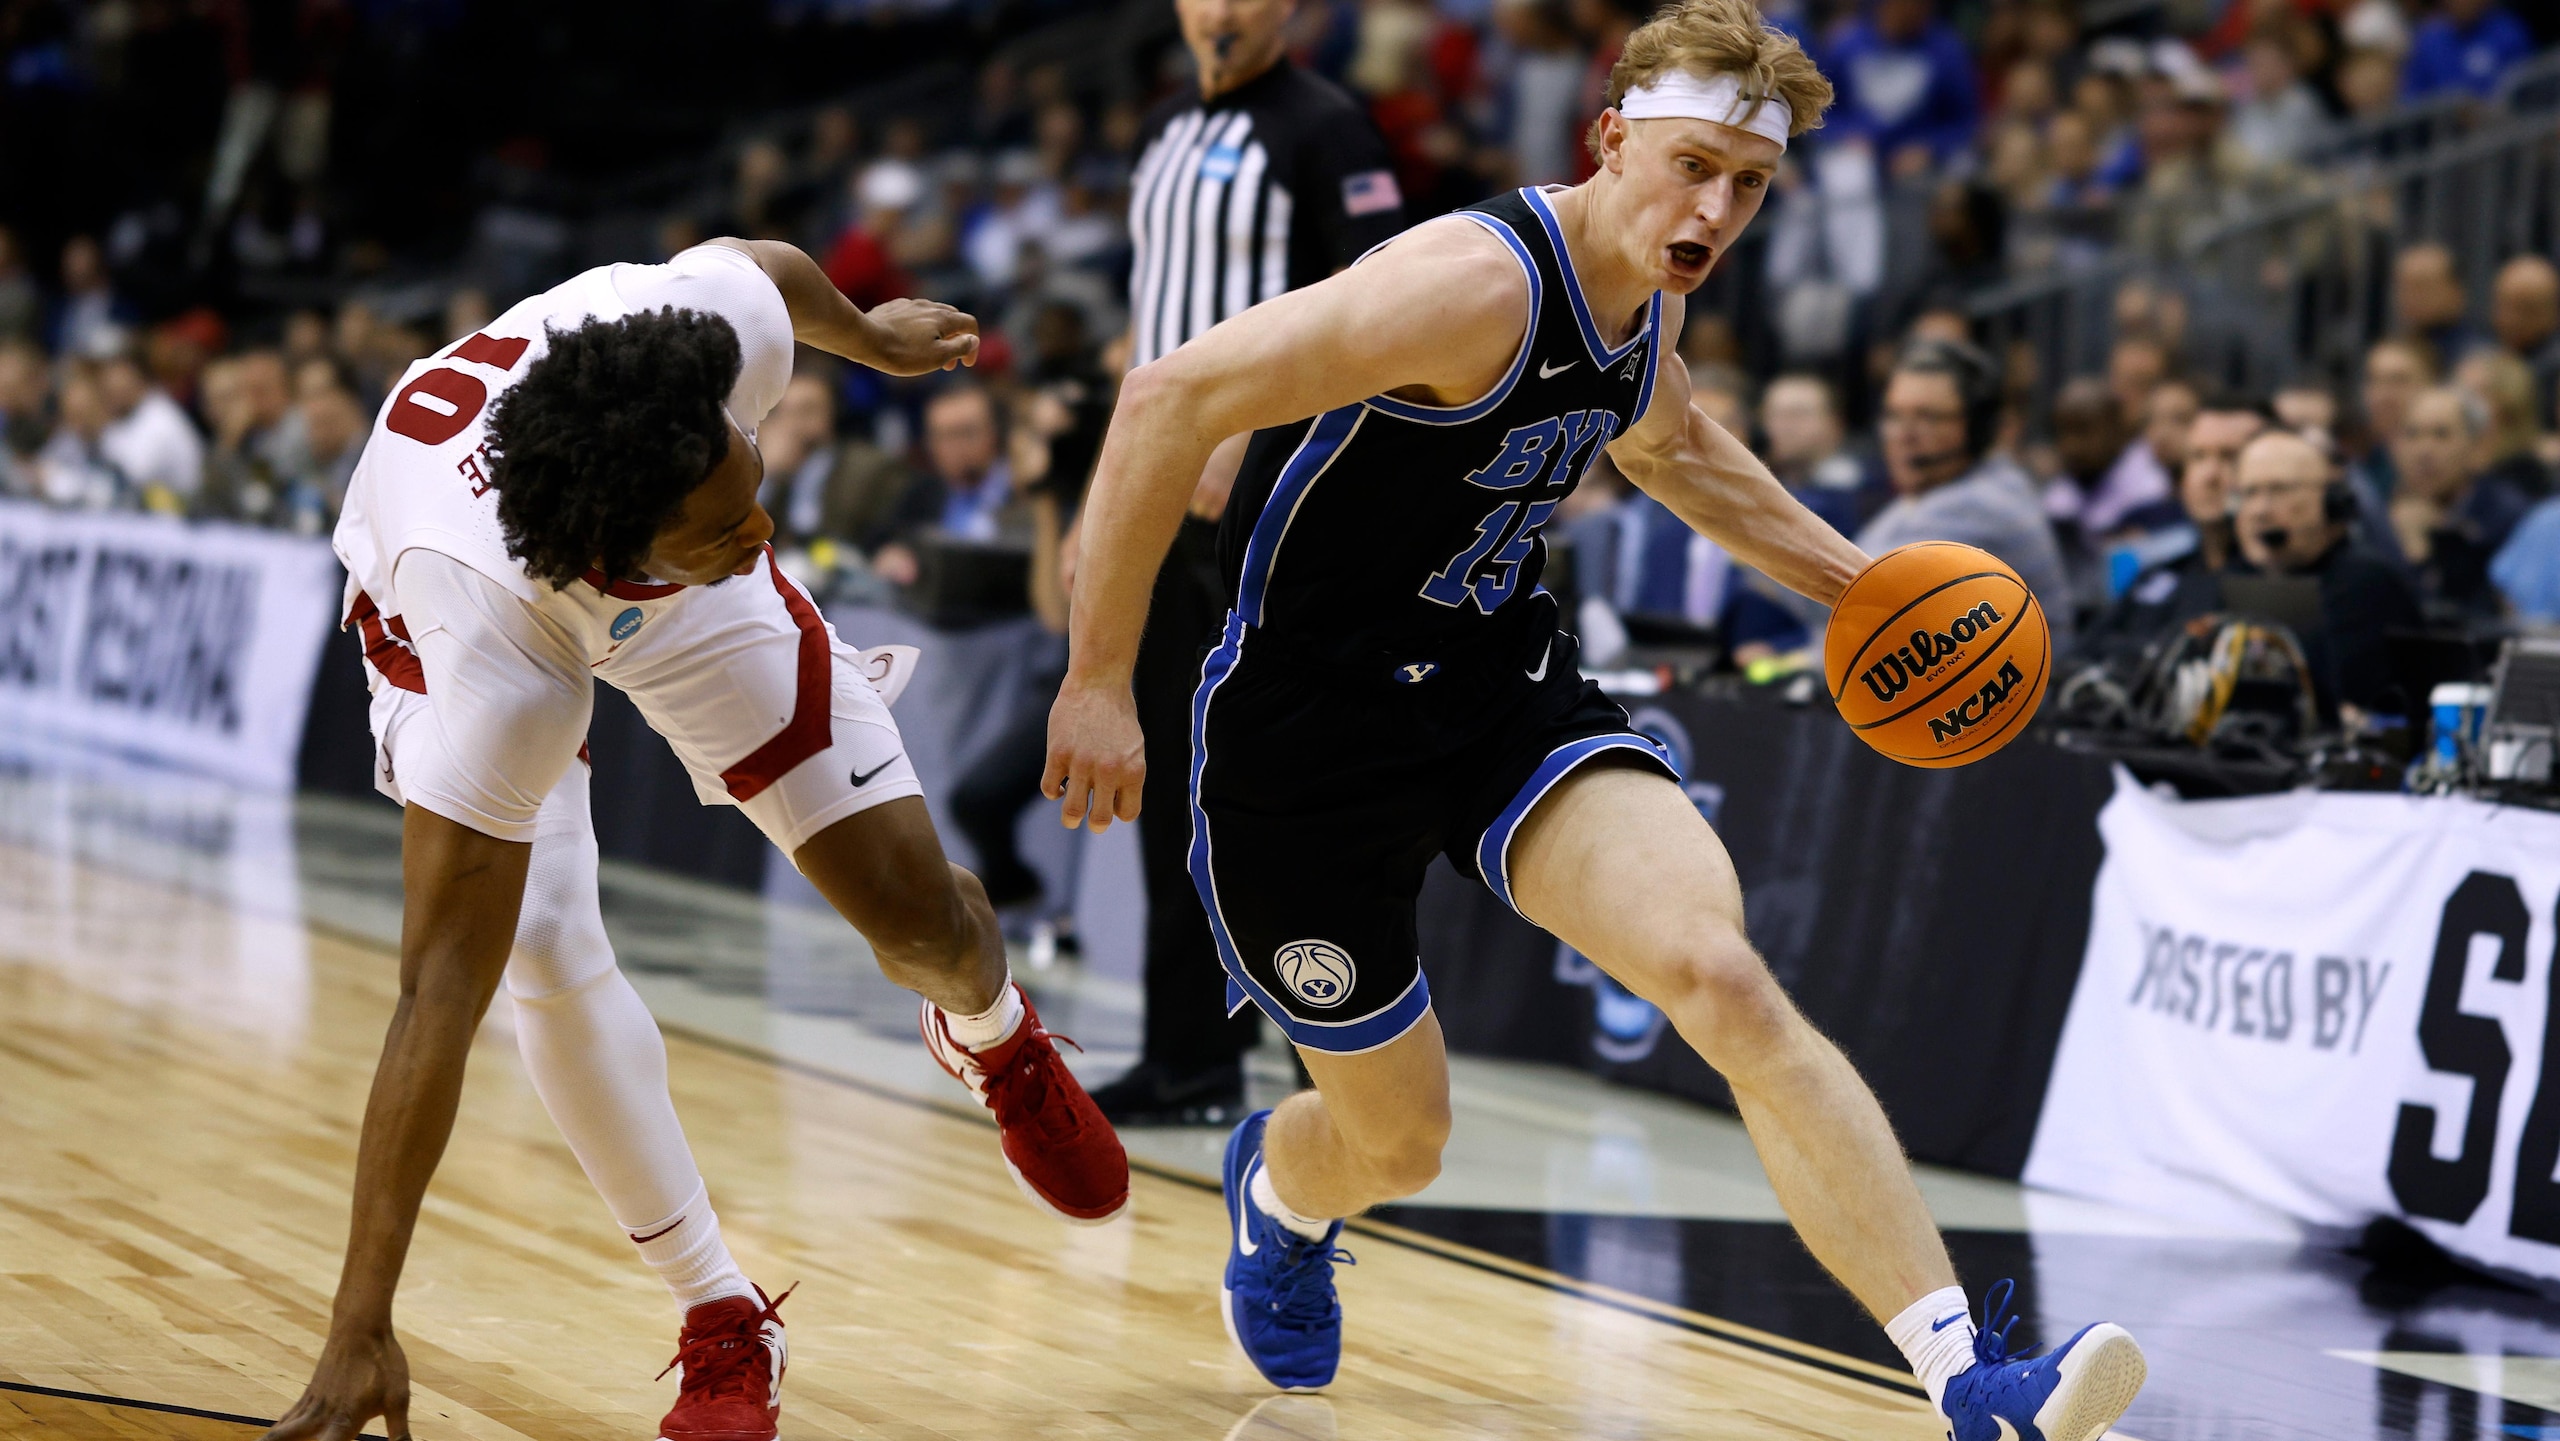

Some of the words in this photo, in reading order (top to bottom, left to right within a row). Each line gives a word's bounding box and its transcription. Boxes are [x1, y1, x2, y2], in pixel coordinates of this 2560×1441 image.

[386, 332, 531, 445] 10
[1418, 497, 1560, 616] 15
[1402, 663, 1436, 683] Y
[1860, 601, 2003, 703] Wilson
[1926, 666, 1946, 683] EVO
[1946, 650, 1967, 667] NXT
[1926, 659, 2024, 743] NCAA
[1982, 706, 2007, 727] GAME
[1305, 980, 1330, 997] Y
[2312, 955, 2392, 1055] BY
